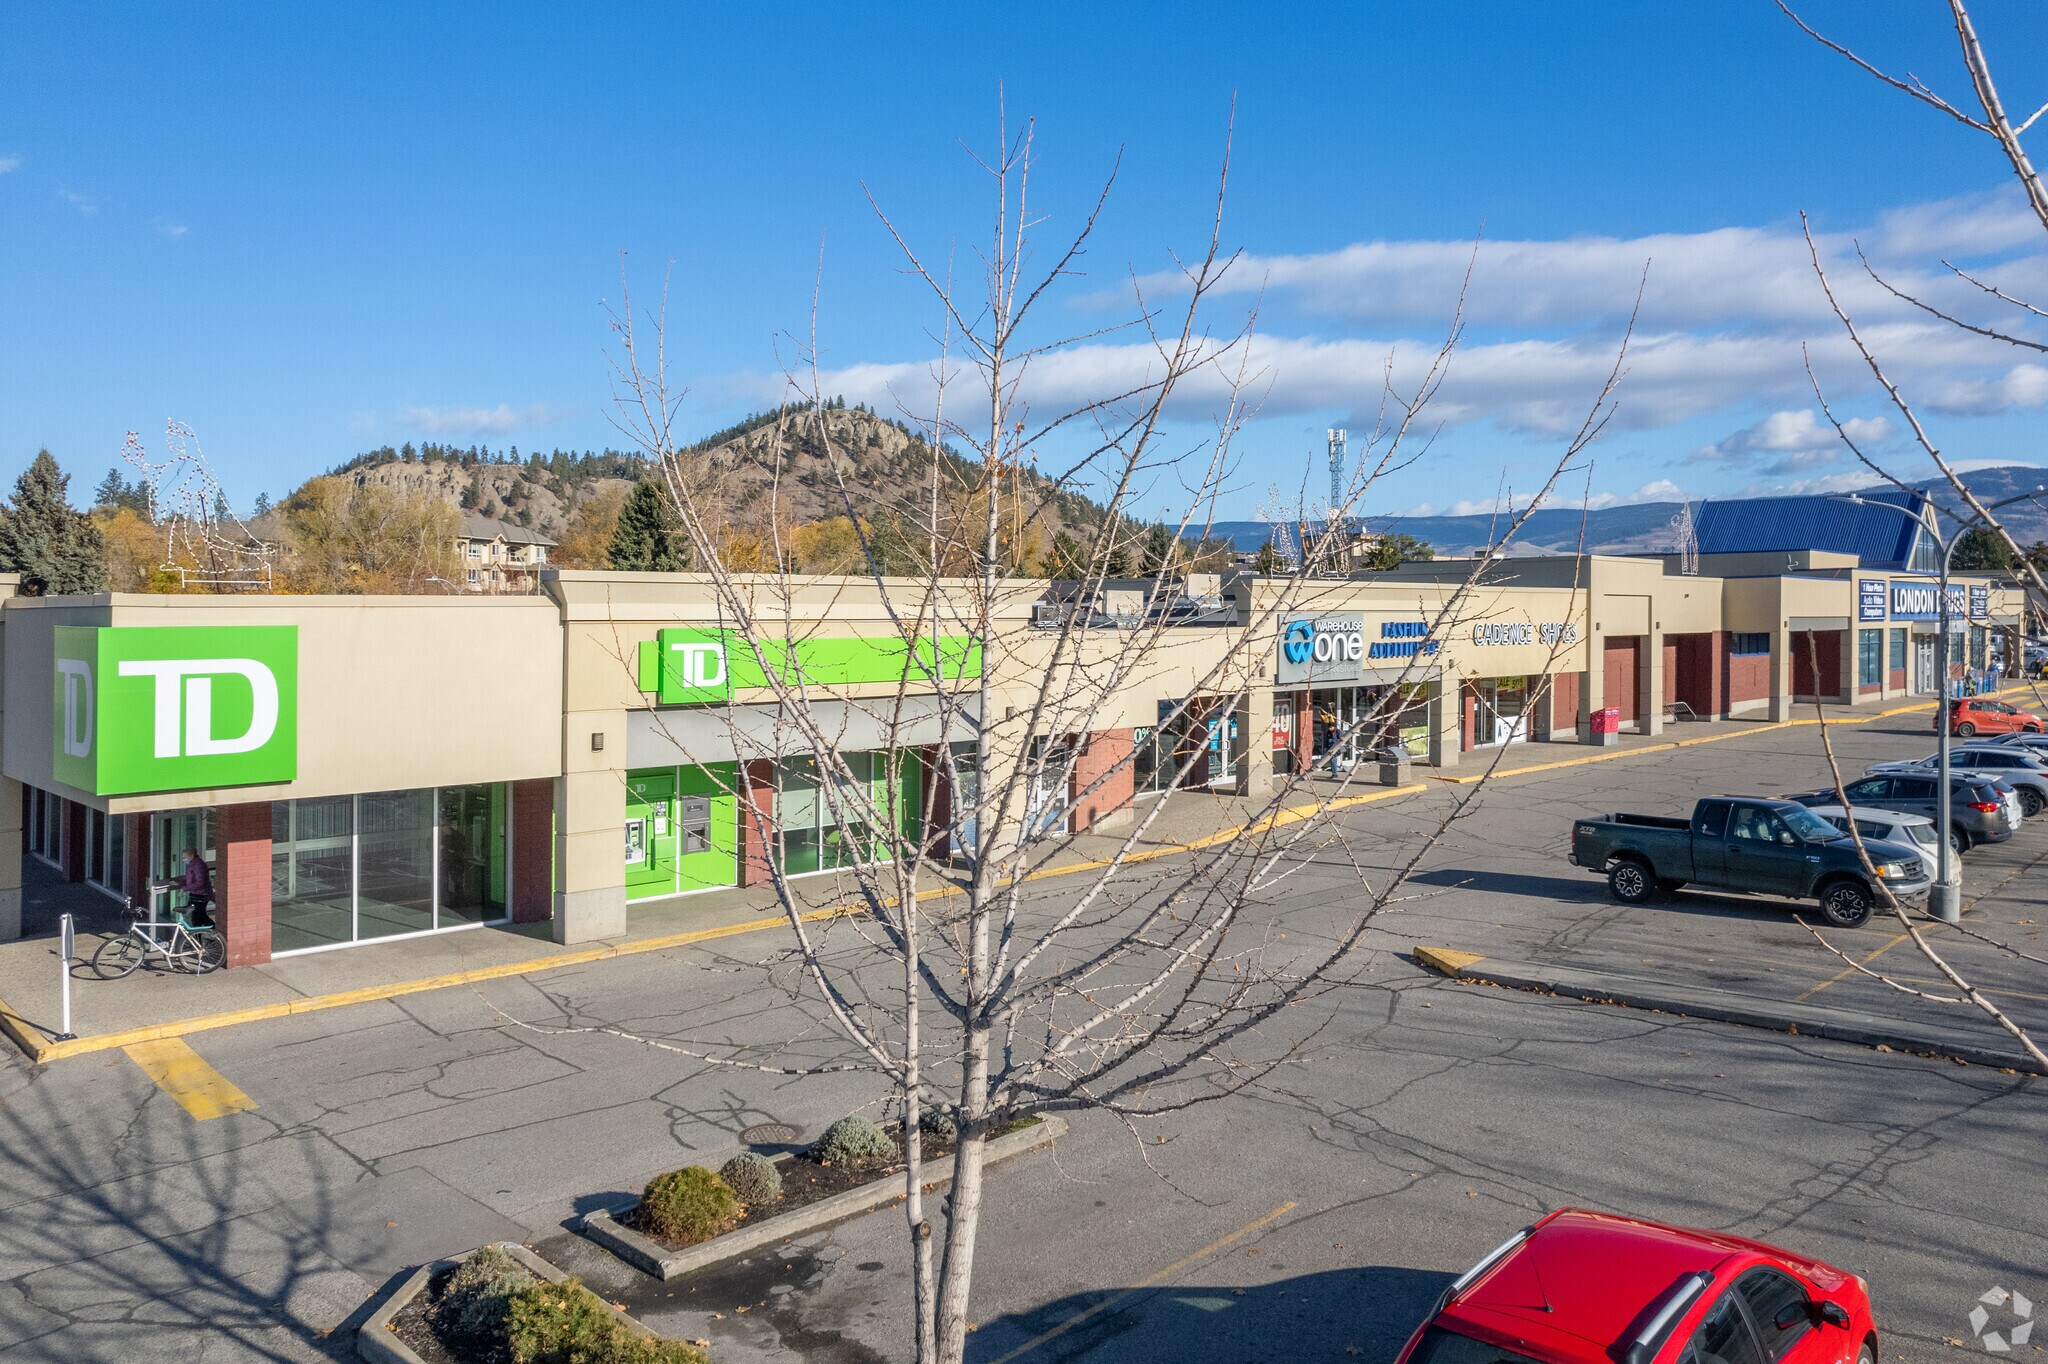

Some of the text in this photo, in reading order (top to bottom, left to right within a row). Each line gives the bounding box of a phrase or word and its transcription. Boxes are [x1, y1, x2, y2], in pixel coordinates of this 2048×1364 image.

[1894, 588, 1965, 614] LONDON DUGS
[1382, 622, 1429, 638] FASHION
[1473, 622, 1577, 646] CADENCE SHOES
[1313, 633, 1363, 662] one
[671, 642, 729, 688] TD
[1339, 663, 1360, 673] STORE
[58, 658, 93, 758] TD
[118, 658, 279, 759] TD
[1271, 703, 1290, 733] 40
[634, 783, 647, 793] TD
